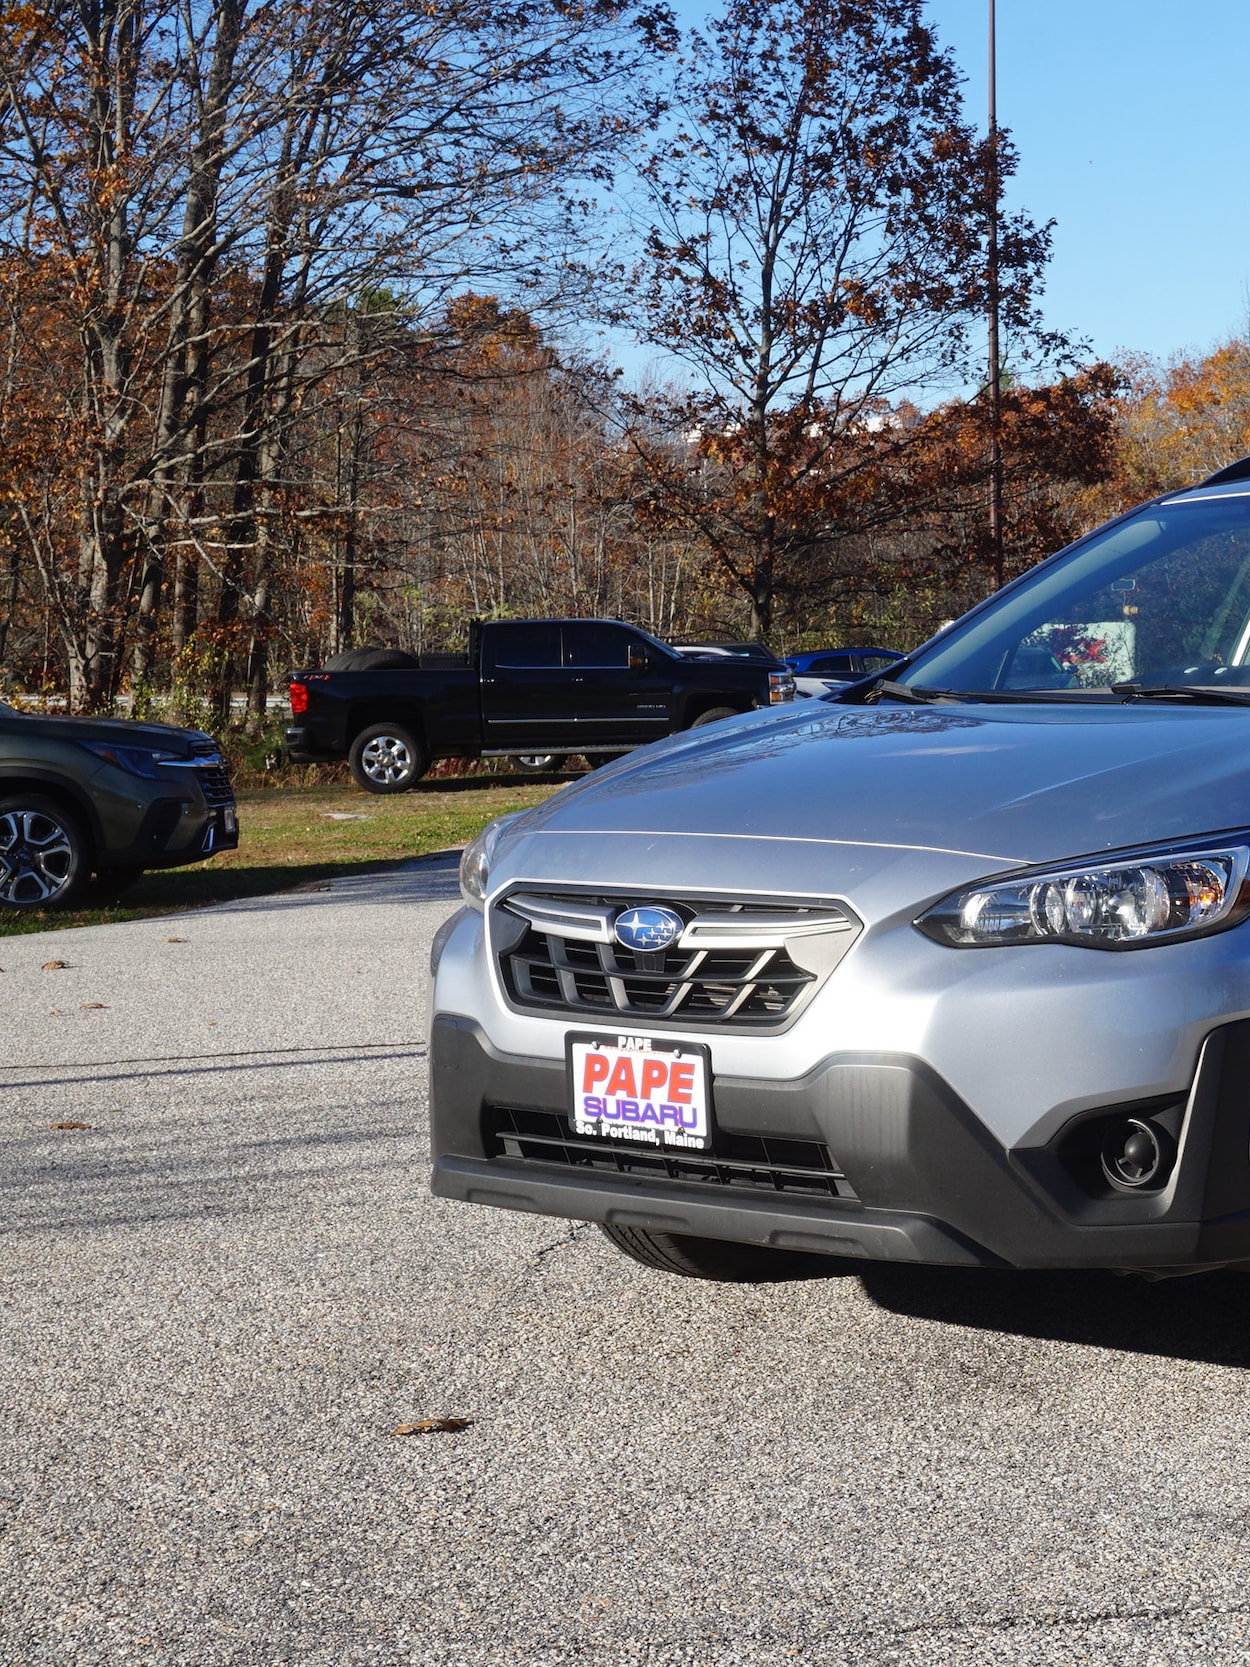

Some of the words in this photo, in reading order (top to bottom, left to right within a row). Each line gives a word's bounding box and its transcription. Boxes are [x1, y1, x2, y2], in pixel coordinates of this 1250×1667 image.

[617, 1036, 653, 1051] PAPE
[583, 1053, 696, 1104] PAPE
[583, 1096, 698, 1129] SUBARU
[575, 1120, 597, 1136] So.
[601, 1123, 660, 1146] Portland,
[664, 1130, 705, 1149] Maine
